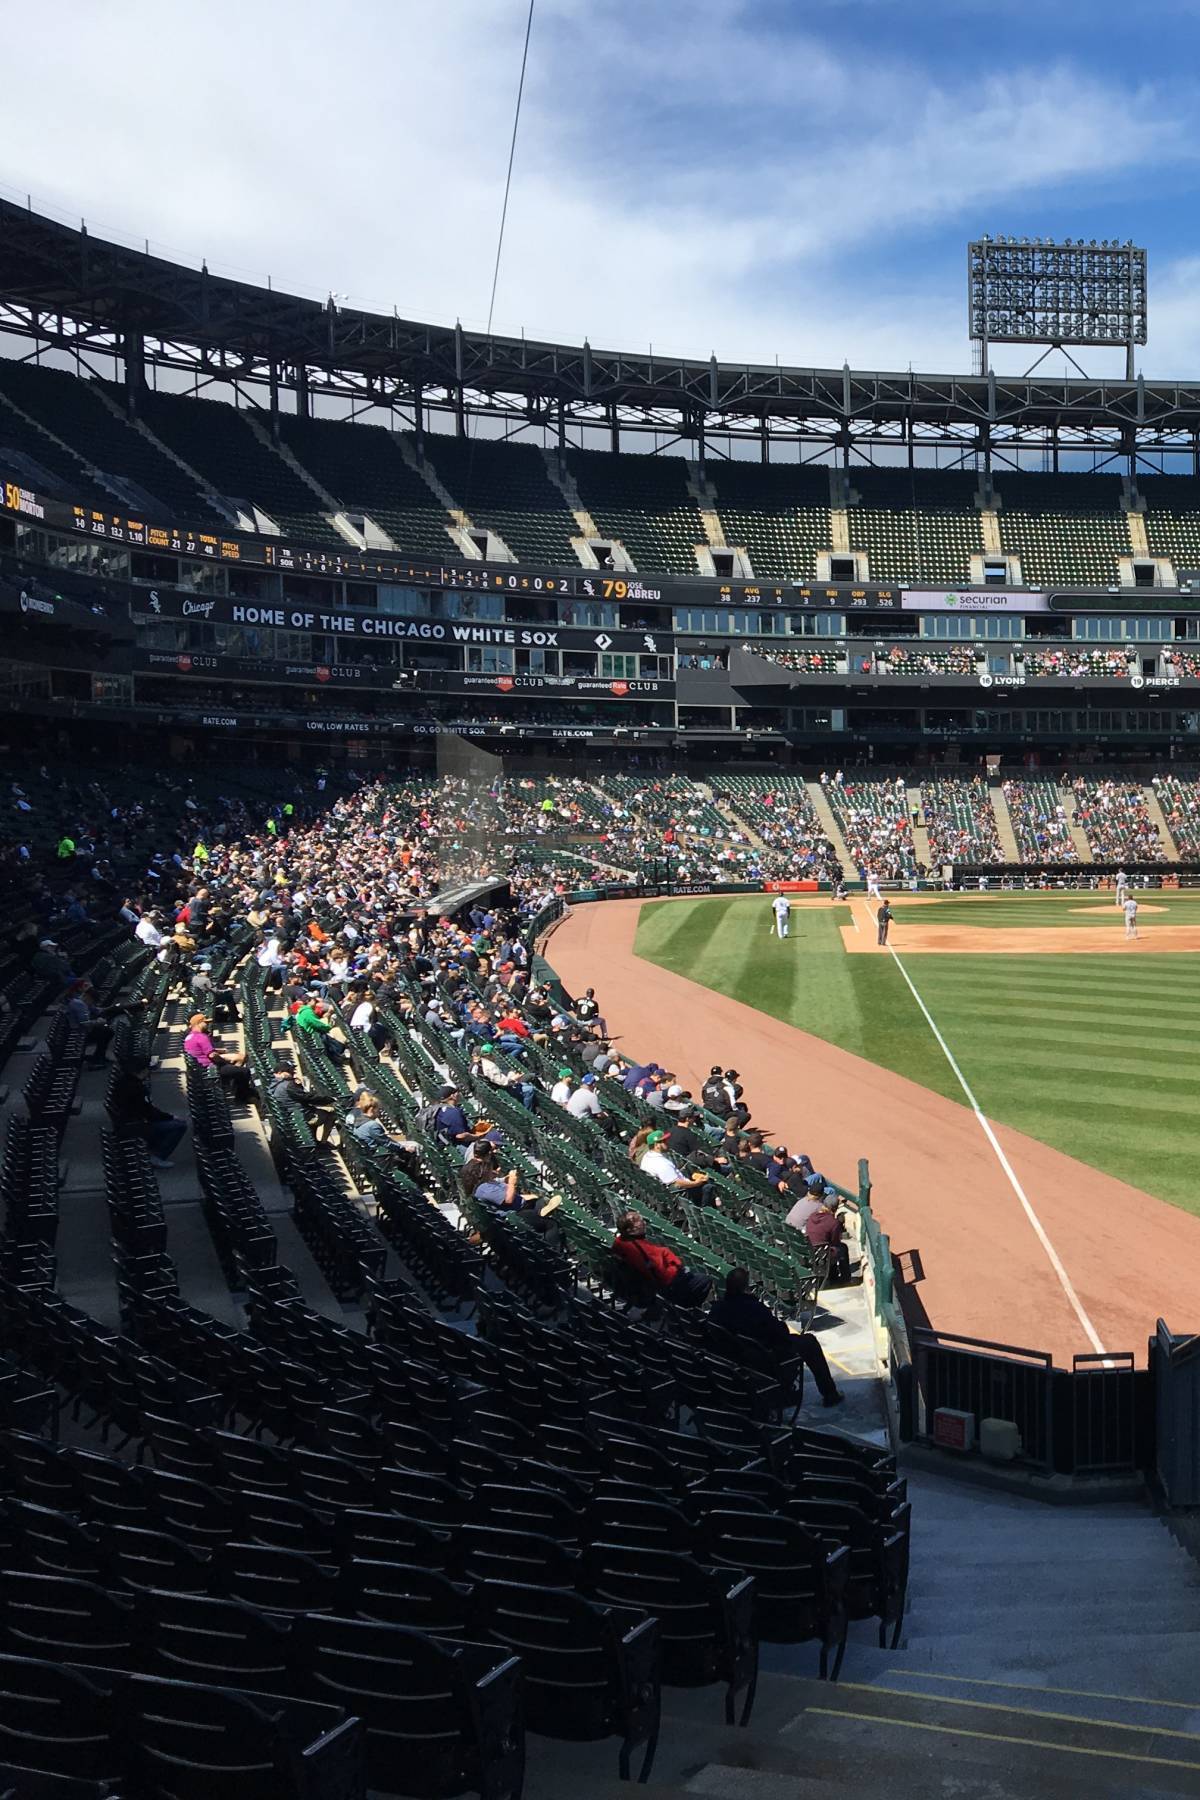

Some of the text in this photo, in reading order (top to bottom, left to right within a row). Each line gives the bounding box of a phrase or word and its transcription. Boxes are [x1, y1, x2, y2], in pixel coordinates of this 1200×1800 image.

[7, 483, 20, 511] 50
[93, 512, 104, 521] ERA
[75, 518, 86, 528] 1-0
[111, 527, 123, 538] 13.2
[129, 532, 143, 542] 1.10
[150, 529, 168, 538] PITCH
[149, 538, 169, 546] COUNT
[171, 540, 181, 549] 21
[199, 535, 218, 545] TOTAL
[186, 542, 195, 551] 27
[204, 545, 214, 554] 48
[222, 542, 239, 551] PITCH
[222, 550, 240, 559] SPEED
[280, 558, 294, 566] SOX
[496, 576, 503, 585] B
[508, 575, 517, 588] 0
[522, 578, 529, 587] S
[534, 577, 543, 590] 0
[559, 580, 568, 592] 2
[602, 580, 627, 598] 79
[626, 582, 643, 590] JOSE
[626, 589, 661, 600] ABREU
[744, 587, 760, 595] AVG
[800, 589, 811, 597] HR
[959, 596, 1007, 604] securian
[182, 600, 215, 618] Chicago
[233, 606, 558, 646] HOME OF THE CHICAGO WHITE SOX
[192, 656, 217, 667] CLUB
[331, 668, 361, 677] CLUB
[464, 677, 498, 686] guaranteed
[515, 678, 544, 687] CLUB
[995, 677, 1026, 685] LYONS
[1146, 678, 1180, 686] PIERCE
[578, 681, 612, 690] guaranteed
[629, 682, 658, 691] CLUB
[203, 717, 237, 726] RATE.COM
[307, 721, 369, 731] LOW, LOW RATES
[413, 726, 485, 735] GO, GO WHITE SOX
[552, 729, 593, 737] RATE.COM
[673, 886, 710, 894] RATE.COM
